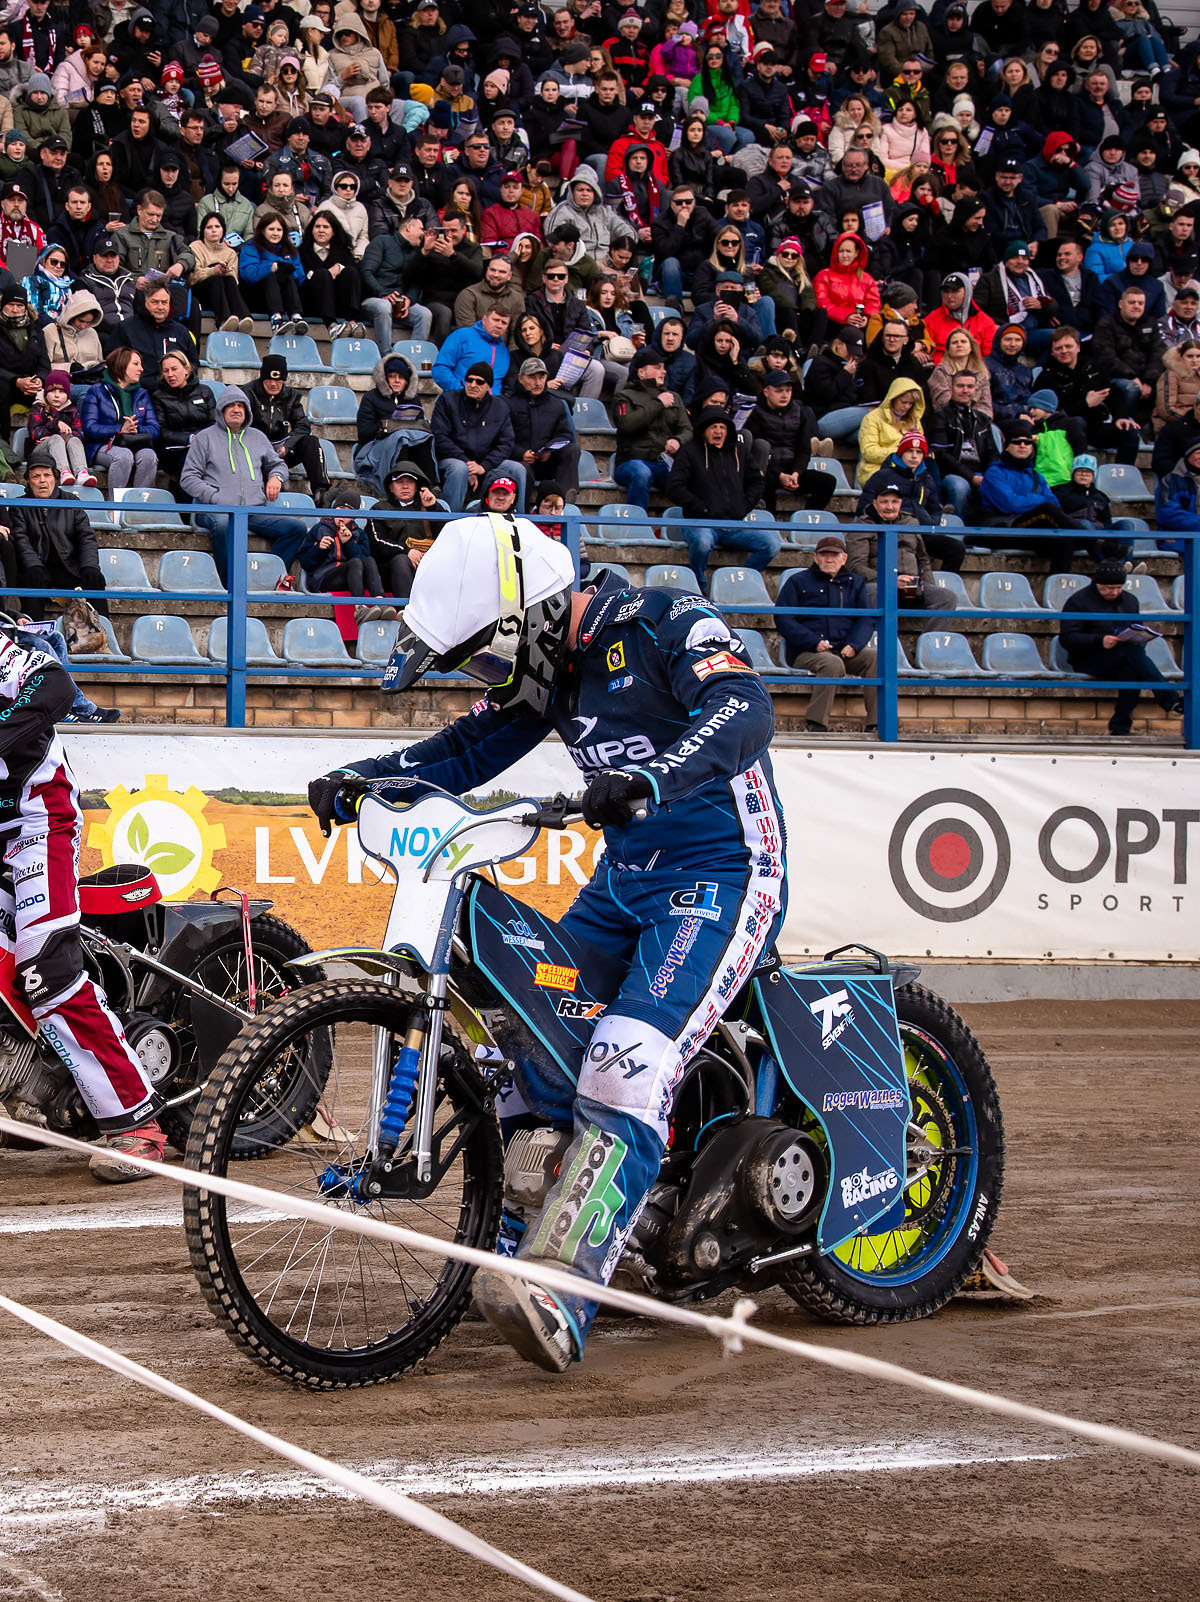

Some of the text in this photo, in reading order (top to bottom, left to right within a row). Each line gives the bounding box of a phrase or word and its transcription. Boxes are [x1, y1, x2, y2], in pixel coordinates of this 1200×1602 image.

[348, 342, 360, 352] 12
[576, 402, 589, 413] 15
[142, 492, 150, 503] 7
[808, 514, 820, 524] 17
[110, 554, 117, 566] 6
[182, 556, 190, 567] 7
[664, 570, 677, 580] 14
[730, 571, 744, 583] 15
[156, 621, 164, 632] 6
[378, 627, 384, 636] 9
[934, 636, 951, 648] 17
[1038, 805, 1200, 885] OPT
[1038, 893, 1184, 913] SPORT
[536, 963, 580, 979] SPEEDWAY
[536, 971, 570, 986] SERVICE
[823, 1088, 903, 1112] Roger Warnes
[842, 1172, 898, 1209] RACING
[967, 1192, 988, 1242] ANLAS
